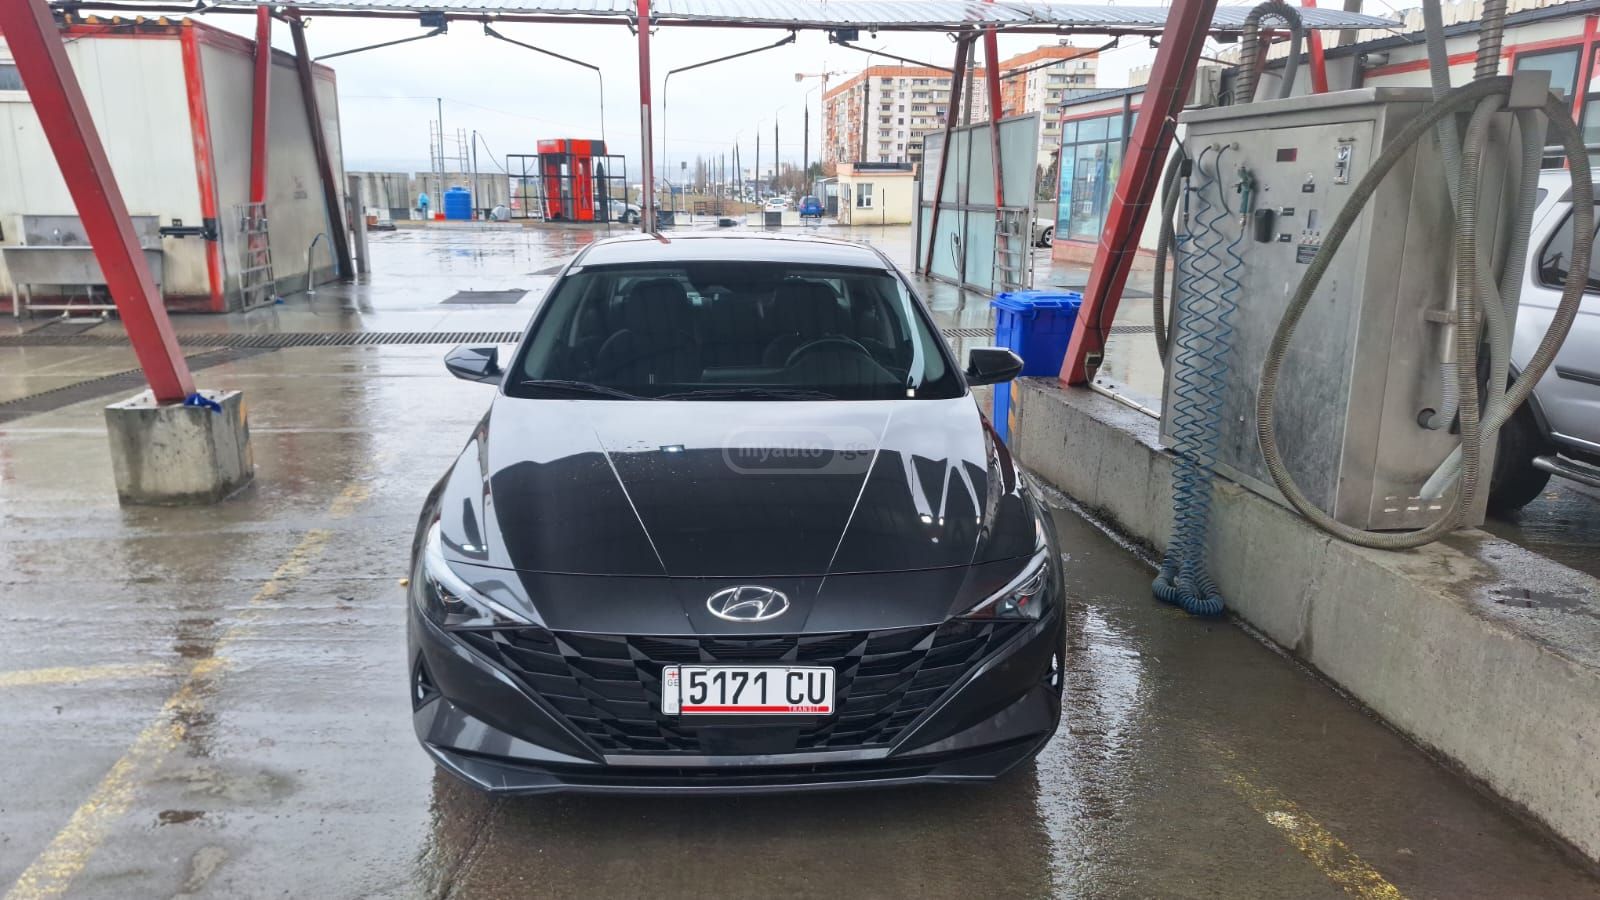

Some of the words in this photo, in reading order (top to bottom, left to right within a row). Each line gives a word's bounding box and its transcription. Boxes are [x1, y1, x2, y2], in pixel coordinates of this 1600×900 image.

[667, 679, 679, 687] GE
[690, 671, 767, 705] 5171
[786, 671, 827, 705] CU
